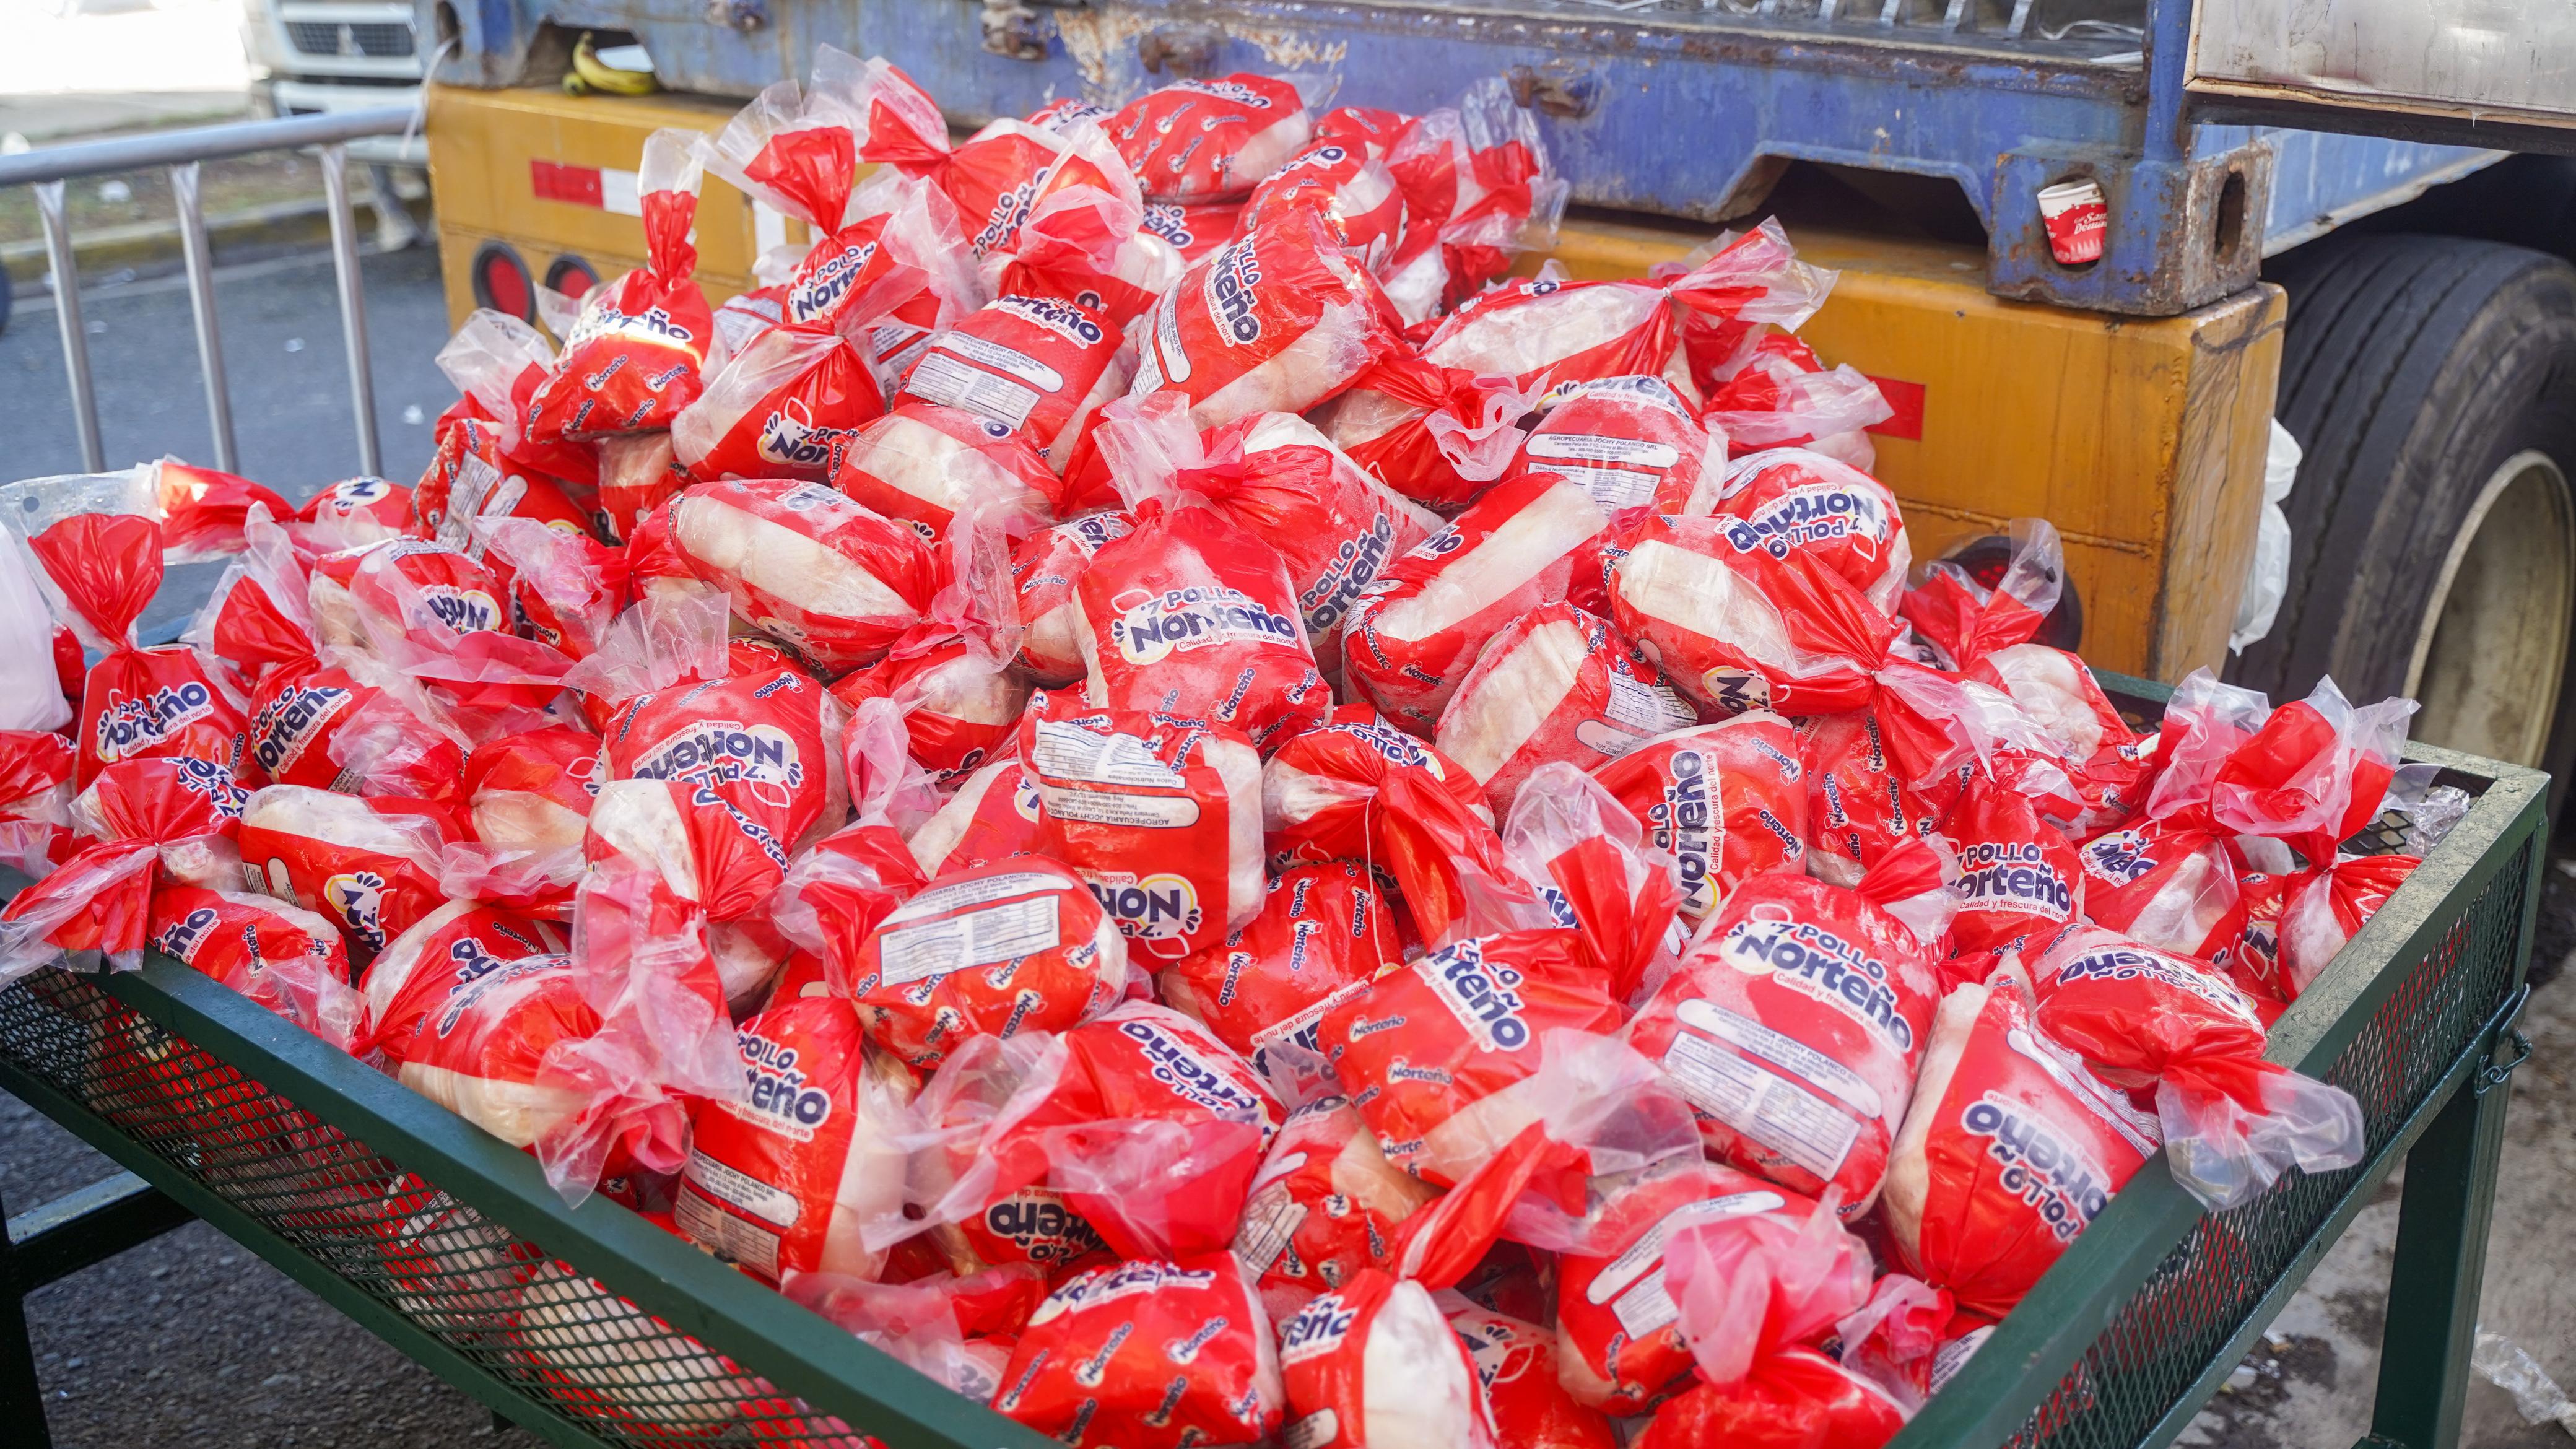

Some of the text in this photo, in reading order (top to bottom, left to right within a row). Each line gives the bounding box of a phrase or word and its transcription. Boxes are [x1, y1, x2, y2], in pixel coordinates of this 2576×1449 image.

[1001, 303, 1025, 316] Calidad
[1067, 330, 1087, 347] norte
[1220, 322, 1233, 344] norte
[592, 355, 627, 389] Norteño
[1007, 347, 1035, 365] POLANCO
[1035, 362, 1045, 372] SRL
[1594, 437, 1614, 445] JOCHY
[1616, 440, 1645, 448] POLANCO
[1806, 484, 1837, 494] Calidad
[1303, 542, 1355, 607] POLLO
[1167, 588, 1244, 608] POLLO
[1132, 603, 1296, 653] Norteño
[1180, 635, 1213, 649] Calidad
[1263, 633, 1276, 642] del
[1276, 637, 1296, 648] norte
[754, 674, 792, 698] Norteño
[1222, 668, 1256, 718] Norteño
[178, 716, 190, 727] del
[190, 706, 211, 721] norte
[280, 751, 298, 772] Calidad
[298, 720, 320, 746] frescura
[319, 708, 329, 721] del
[329, 694, 350, 710] norte
[619, 696, 648, 742] Norteño
[707, 721, 741, 731] Calidad
[665, 727, 697, 746] frescura
[1865, 716, 1883, 767] Norteño
[633, 752, 653, 768] norte
[1707, 754, 1715, 776] norte
[1751, 738, 1799, 775] Norteño
[1108, 774, 1154, 783] Nutricionales
[1081, 812, 1104, 821] JOCHY
[1823, 772, 1845, 824] Norteño
[1889, 777, 1904, 830] Norteño
[1107, 816, 1169, 825] AGROPECUARIA
[1759, 809, 1802, 854] Norteño
[1710, 835, 1721, 871] Calidad
[1967, 844, 2041, 865] POLLO
[1290, 881, 1308, 918] Norteño
[1952, 864, 2070, 911] orteño
[1353, 890, 1370, 937] Norteño
[1960, 899, 1990, 910] Calidad
[1999, 899, 2038, 910] frescura
[2040, 905, 2051, 915] del
[199, 920, 219, 940] norte
[246, 925, 263, 971] Norteño
[1292, 923, 1315, 971] Norteño
[1799, 925, 1884, 979] POLLO
[1220, 954, 1242, 1006] Norteño
[1432, 945, 1525, 1047] rteño
[1735, 934, 1911, 1049] Norteño
[1777, 973, 1816, 992] Calidad
[1825, 990, 1864, 1022] frescura
[1277, 1017, 1294, 1032] del
[1353, 1017, 1405, 1037] Norteño
[1123, 1022, 1258, 1108] orteño
[1777, 1036, 1806, 1054] JOCHY
[1806, 1050, 1847, 1076] POLANCO
[1154, 1066, 1219, 1107] OLLO
[1392, 1068, 1453, 1084] Norteño
[1382, 1140, 1422, 1155] Norte
[1966, 1103, 2108, 1221] orteño
[723, 1168, 740, 1181] JOCHY
[740, 1175, 765, 1193] POLANCO
[765, 1188, 776, 1198] SRL
[2004, 1167, 2078, 1239] POLLO
